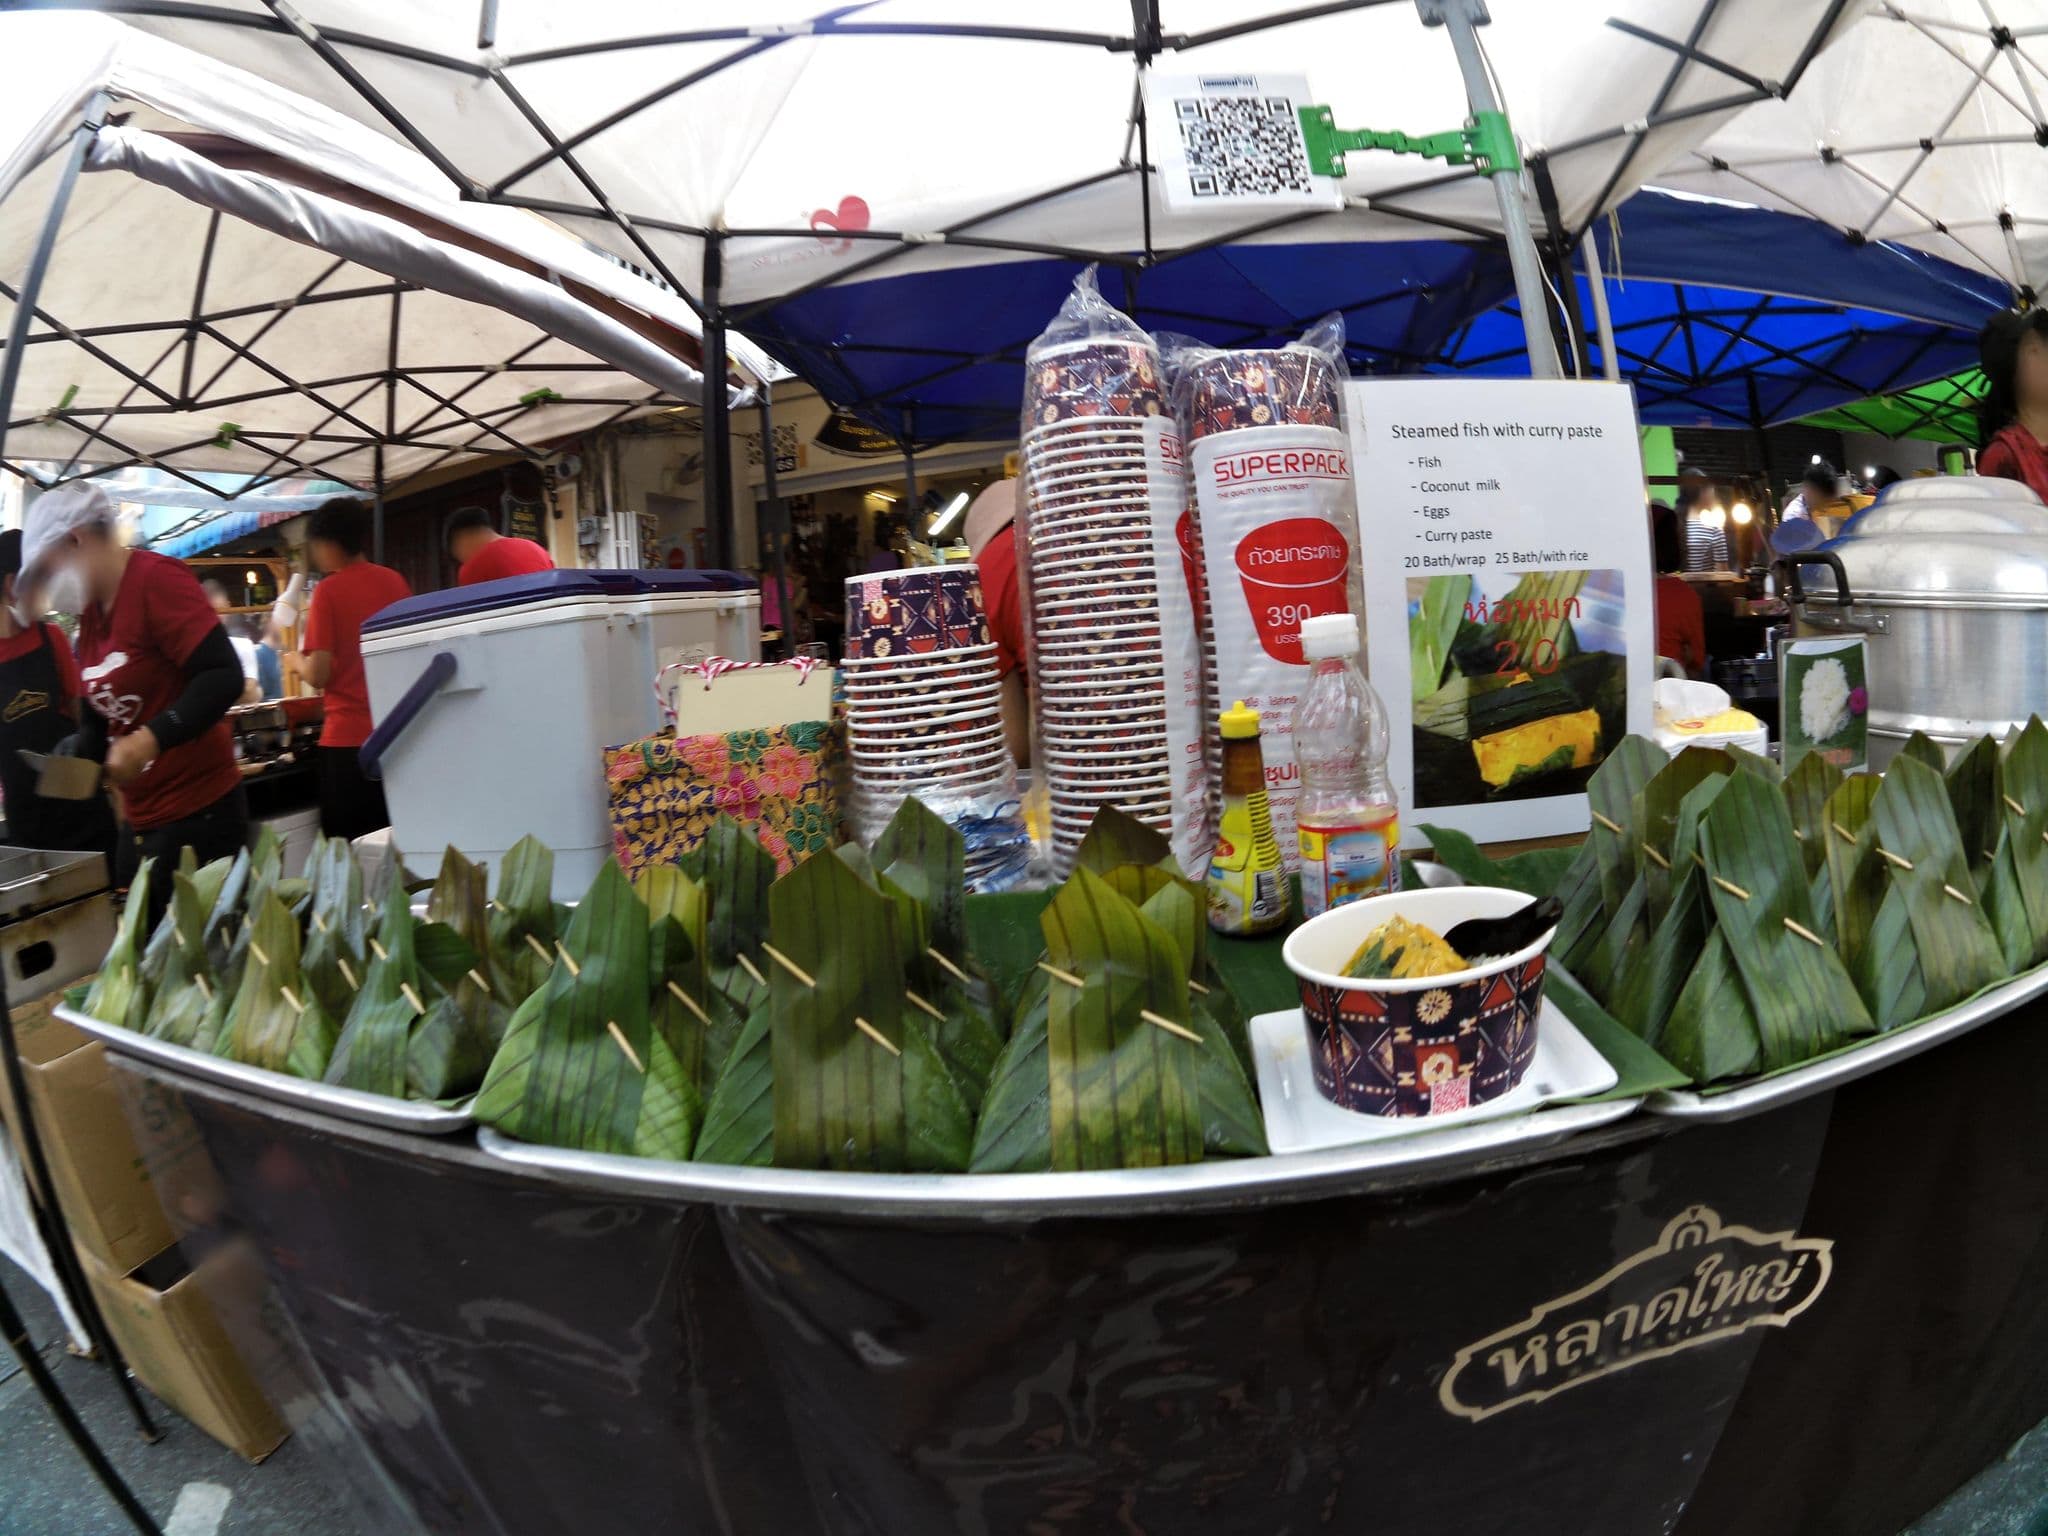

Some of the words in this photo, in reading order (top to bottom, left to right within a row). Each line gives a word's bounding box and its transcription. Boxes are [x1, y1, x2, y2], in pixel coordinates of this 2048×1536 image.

[1391, 423, 1459, 439] Steamed
[1463, 422, 1490, 437] fish
[1494, 422, 1525, 437] with
[1529, 424, 1563, 440] curry
[1567, 425, 1603, 440] paste
[1214, 453, 1350, 482] SUPERPACK
[1418, 456, 1442, 469] Fish
[1231, 488, 1255, 498] QUALITY
[1257, 485, 1271, 493] YOU
[1273, 484, 1287, 492] CAN
[1420, 480, 1470, 493] Coconut
[1476, 479, 1501, 491] milk
[1423, 505, 1450, 519] Eggs
[1425, 530, 1457, 543] Curry
[1461, 529, 1493, 542] paste
[1248, 545, 1341, 566] ถ้วยกระดาษ
[1405, 556, 1420, 568] 20
[1423, 554, 1486, 568] Bath/wrap
[1495, 552, 1509, 564] 25
[1513, 550, 1567, 564] Bath/with
[1569, 550, 1589, 561] rice
[1267, 604, 1312, 627] 390
[1463, 594, 1580, 624] ห่อหมก
[1487, 1253, 1808, 1388] หลาดใหญ่
